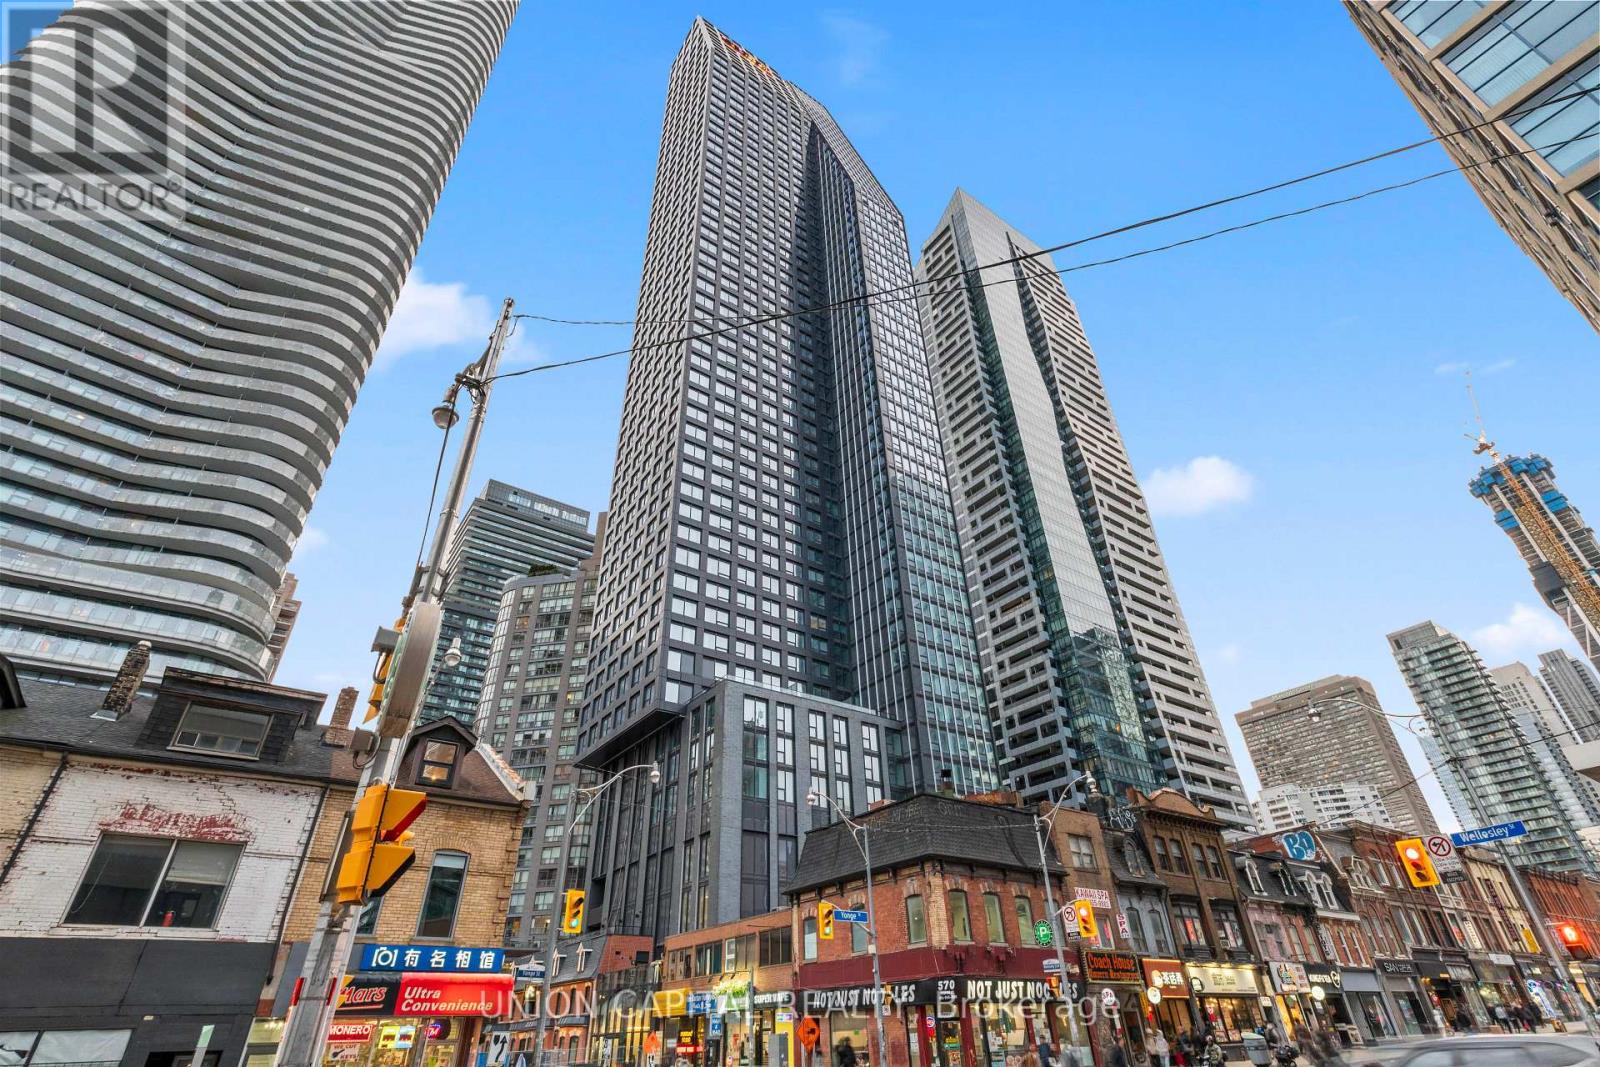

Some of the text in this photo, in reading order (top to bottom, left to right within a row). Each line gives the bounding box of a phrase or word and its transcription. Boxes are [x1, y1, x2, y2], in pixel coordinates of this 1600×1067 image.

[1459, 827, 1509, 842] Wellesley
[1097, 890, 1109, 900] SPA
[841, 911, 857, 921] Yonge
[1117, 914, 1129, 934] SPA
[404, 948, 496, 969] 有名相馆
[1088, 952, 1136, 969] Coach House
[937, 979, 955, 991] 570
[968, 980, 992, 1000] NOT
[995, 981, 1024, 999] JUST
[404, 986, 441, 999] Ultra
[754, 993, 772, 1004] SUPER
[772, 991, 790, 1003] VAPE
[813, 991, 833, 1009] NOT
[834, 989, 860, 1007] JUST
[401, 999, 493, 1012] Convenience
[329, 1025, 370, 1035] MONERO
